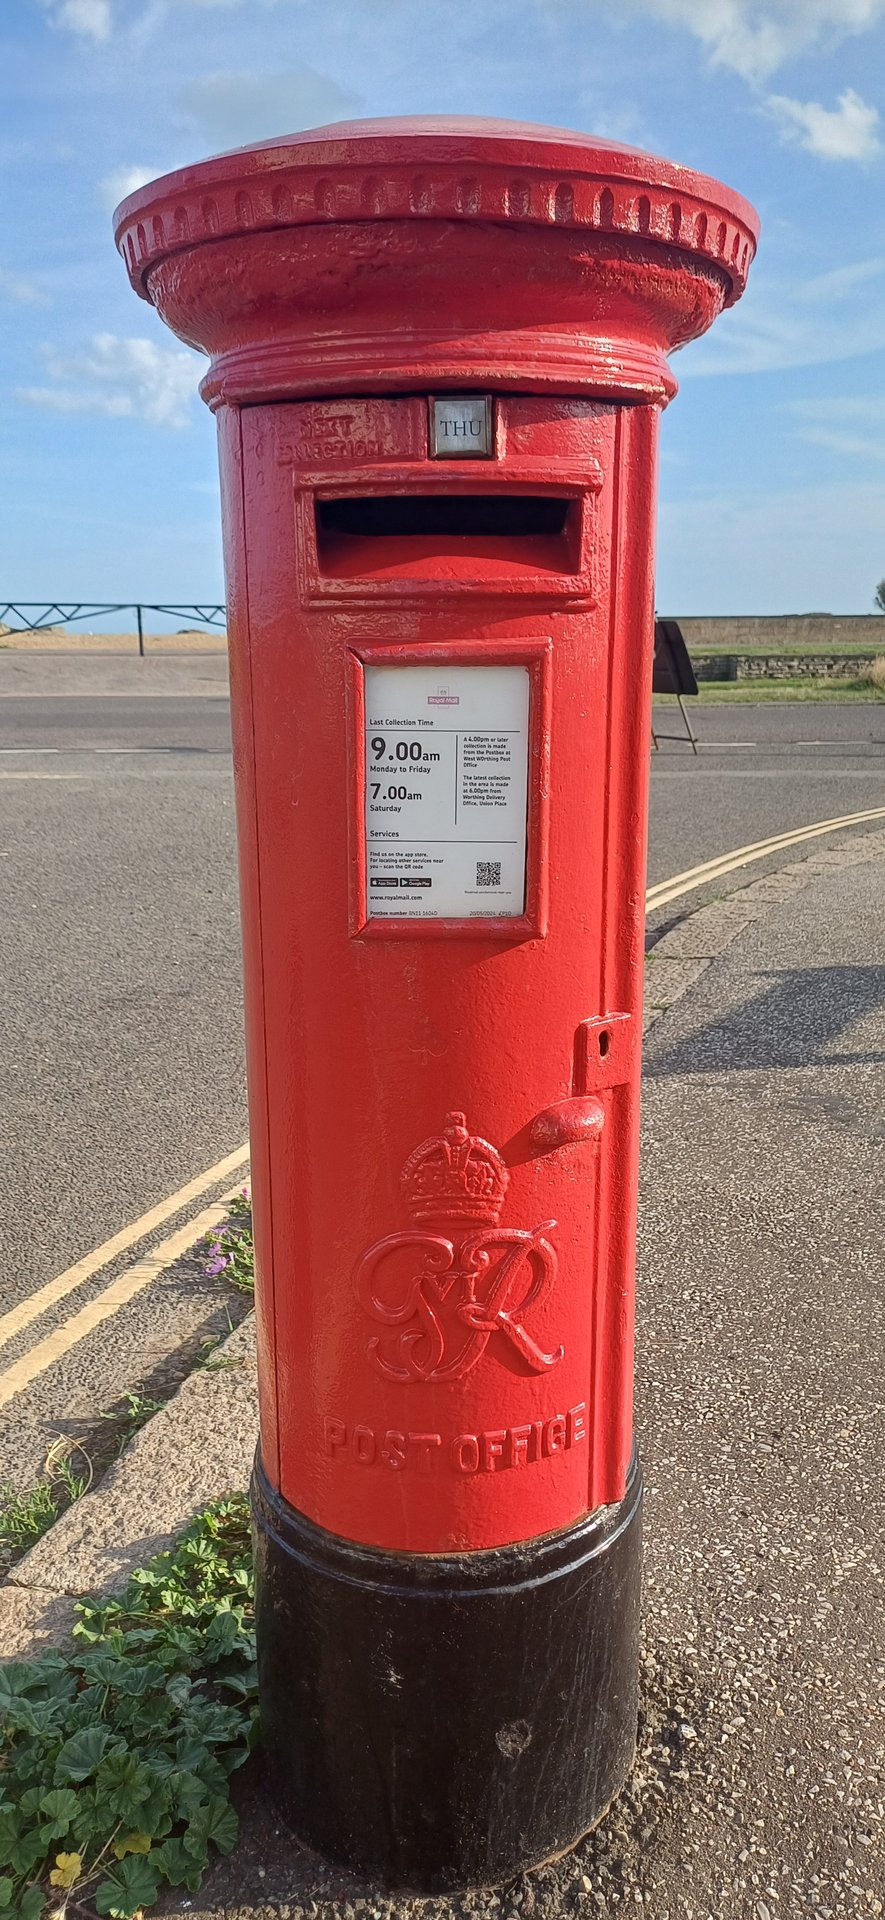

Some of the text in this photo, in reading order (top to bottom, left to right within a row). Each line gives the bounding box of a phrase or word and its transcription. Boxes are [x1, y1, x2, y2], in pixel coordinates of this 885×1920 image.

[440, 420, 483, 436] THU
[280, 439, 383, 463] LLECTION
[385, 718, 416, 726] Collection
[371, 737, 440, 761] 9.00am
[370, 765, 397, 774] Monday
[409, 765, 431, 774] Friday
[370, 783, 422, 800] 7.00am
[370, 804, 402, 813] Saturday
[370, 830, 400, 838] Services
[322, 1401, 587, 1475] POST OFFICE
